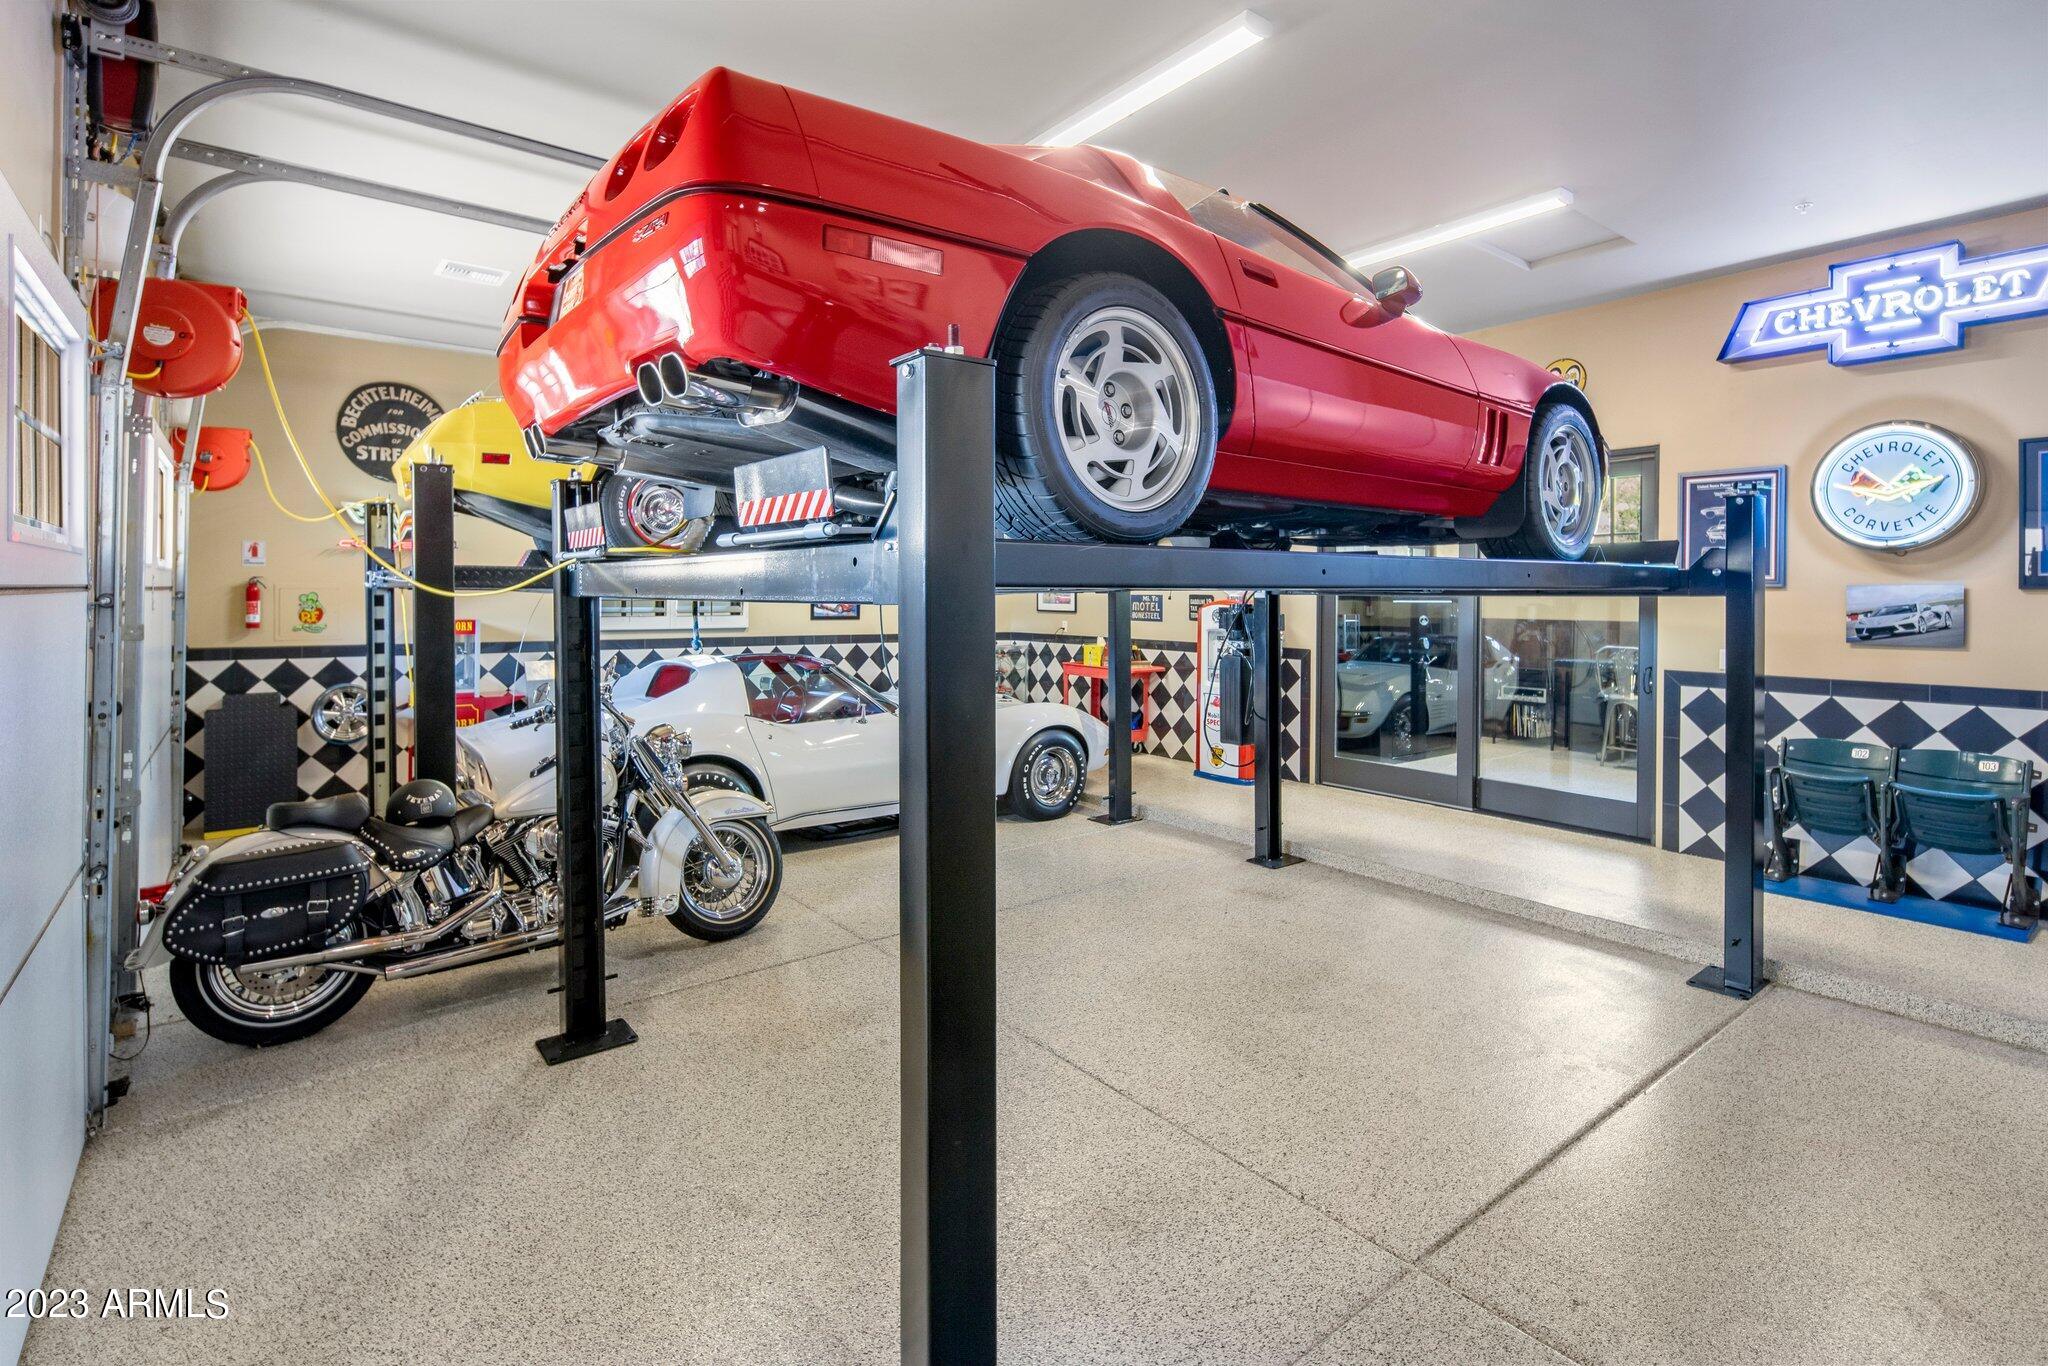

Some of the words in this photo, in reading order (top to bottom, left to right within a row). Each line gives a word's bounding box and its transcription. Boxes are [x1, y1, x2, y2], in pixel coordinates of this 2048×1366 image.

[1773, 268, 2032, 336] CHEVROLET
[387, 408, 404, 416] FOR
[341, 422, 421, 448] COMMISSIO
[356, 445, 404, 461] STRE
[1841, 441, 1945, 473] CHEVROLET
[1843, 503, 1940, 532] CORVETTE
[1132, 601, 1160, 612] MOTEL
[455, 621, 473, 631] ORN
[456, 718, 475, 728] ORN
[1855, 750, 1868, 758] 102
[1981, 762, 1997, 772] 103
